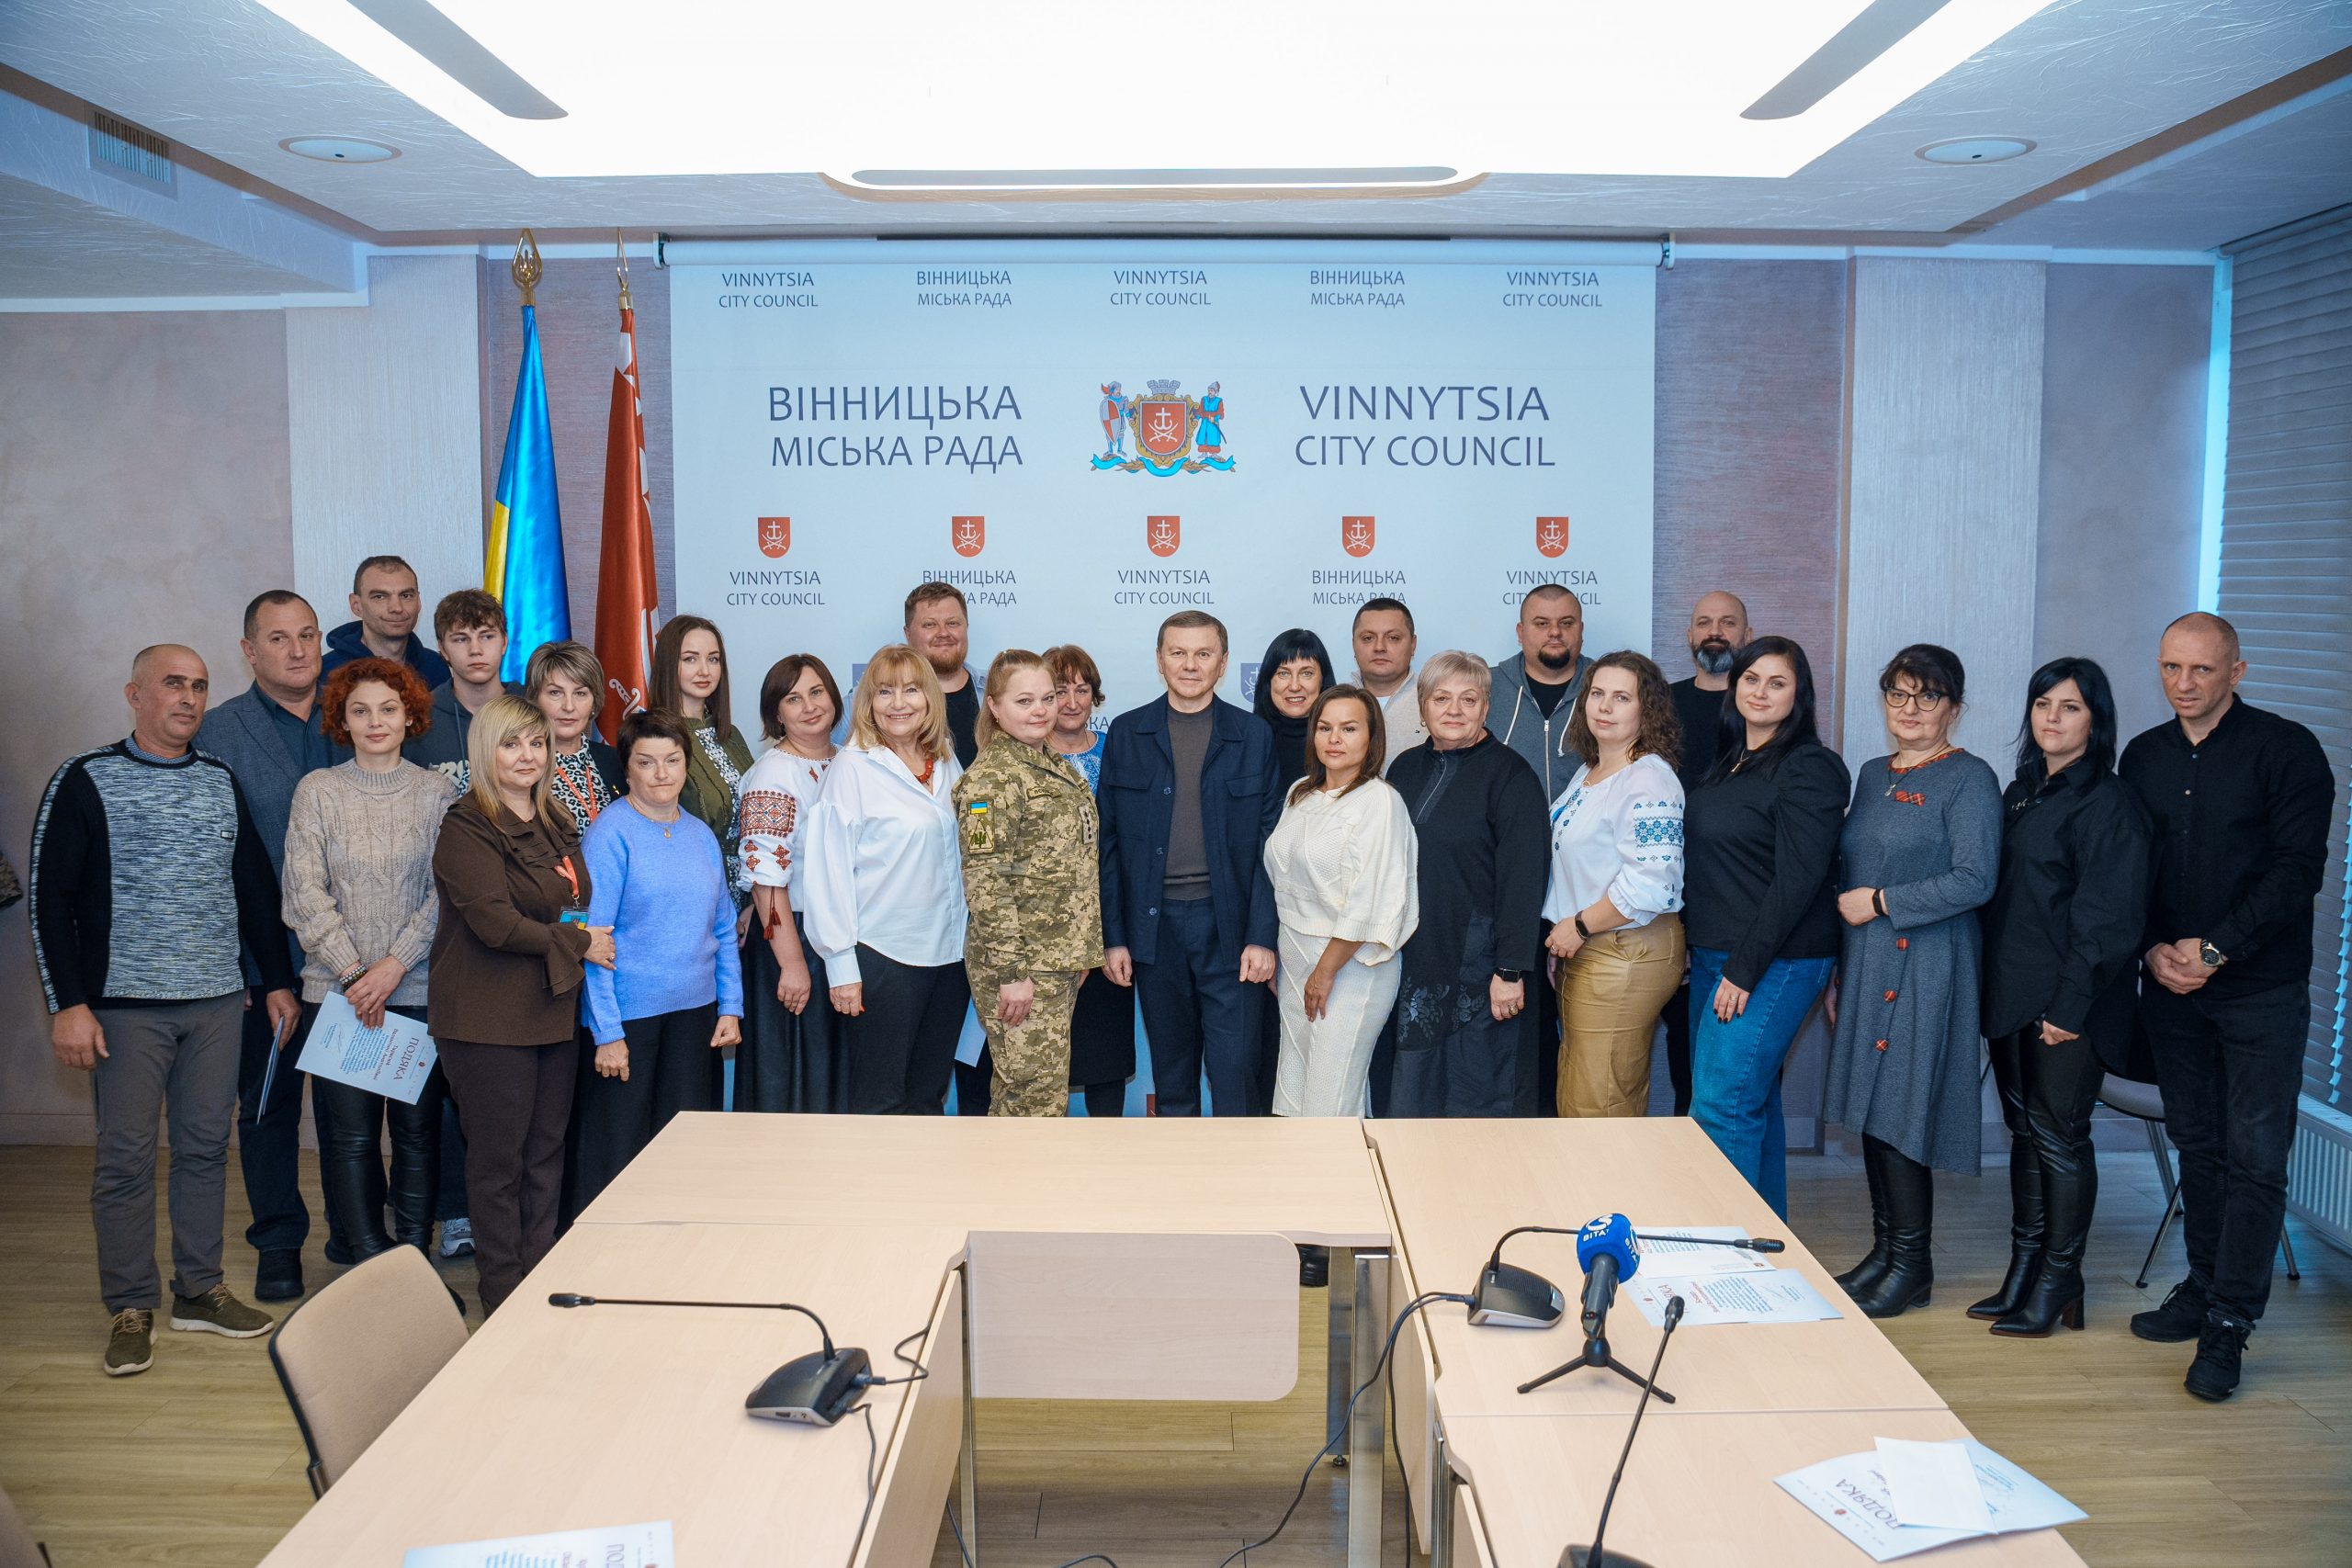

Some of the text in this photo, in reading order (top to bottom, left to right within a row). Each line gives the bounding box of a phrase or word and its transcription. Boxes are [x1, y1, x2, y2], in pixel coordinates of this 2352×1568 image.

[721, 272, 814, 288] VINNYTSIA
[917, 270, 1012, 288] ВІННИЦЬКА
[1114, 270, 1207, 285] VINNYTSIA
[1310, 270, 1405, 288] ВІННИЦЬКА
[1506, 271, 1600, 287] VINNYTSIA
[718, 294, 819, 309] CITY COUNCIL
[918, 292, 1012, 309] МІСЬКА РАДА
[1110, 292, 1212, 306] CITY COUNCIL
[1310, 292, 1405, 310] МІСЬКА РАДА
[1502, 293, 1601, 308] CITY COUNCIL
[769, 385, 1022, 431] ВІННИЦЬКА
[1299, 385, 1550, 422] VINNYTSIA
[772, 435, 1023, 475] МІСЬКА РАДА
[1295, 434, 1556, 467] CITY COUNCIL
[729, 570, 821, 585] VINNYTSIA
[922, 570, 1017, 588] ВІННИЦЬКА
[1117, 570, 1211, 584] VINNYTSIA
[1312, 570, 1406, 589] ВІННИЦЬКА
[1506, 570, 1599, 585] VINNYTSIA
[727, 592, 825, 606] CITY COUNCIL
[979, 592, 1017, 608] РАДА
[1114, 592, 1215, 604] CITY COUNCIL
[1313, 592, 1366, 606] МІСЬКА
[1502, 592, 1529, 605] CIT
[394, 1037, 420, 1080] ПОДЯКА
[1836, 1478, 1900, 1529] ПОДЯКА
